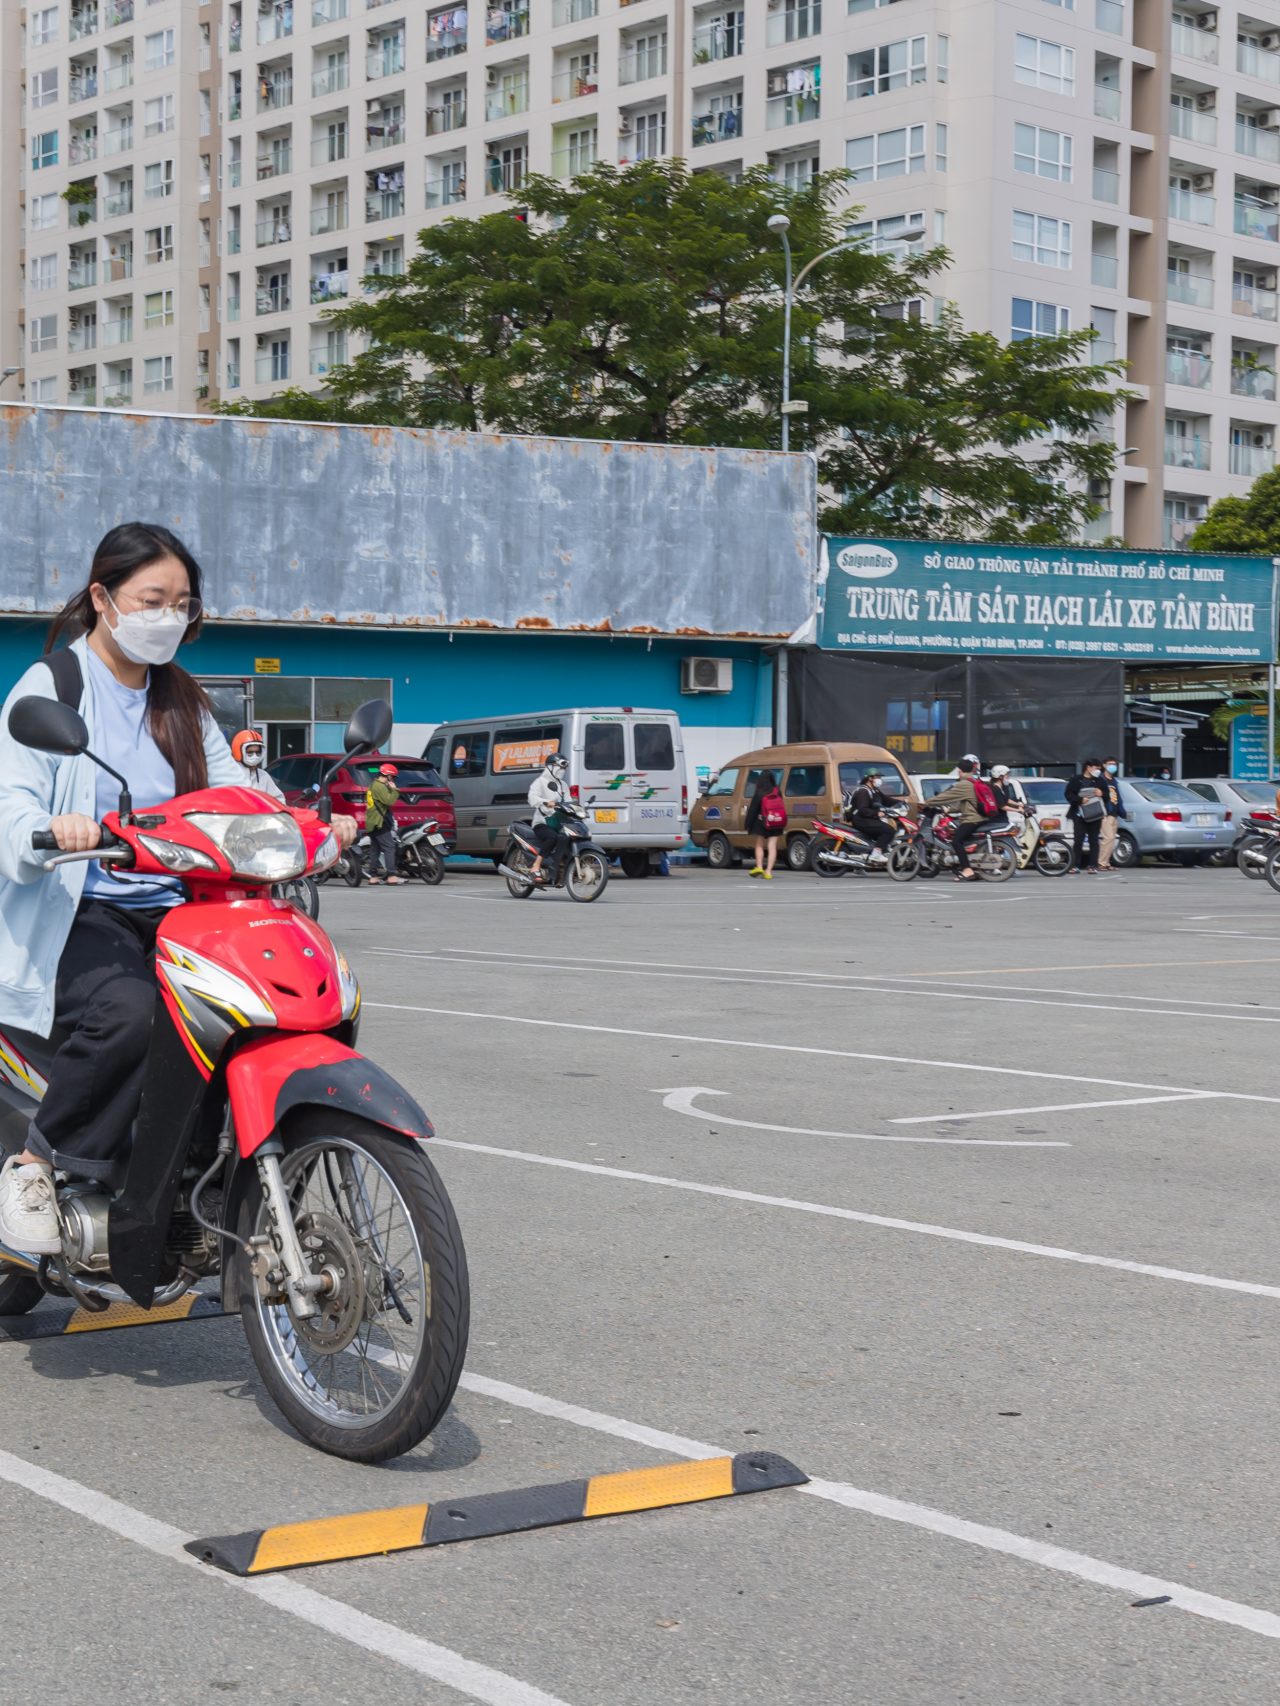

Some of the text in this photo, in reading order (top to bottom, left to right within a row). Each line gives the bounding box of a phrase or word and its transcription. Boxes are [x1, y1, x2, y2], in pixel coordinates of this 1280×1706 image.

[842, 553, 894, 569] SaigonBus
[923, 551, 1225, 582] SỞ GIAO THÔNG VẬN TẢI THÀNH PHỐ HỒ CHÍ MINH
[846, 582, 1255, 632] TRUNG TÂM SÁT HẠCH LÁI XE TÂN BÌNH
[248, 918, 294, 928] HONDA
